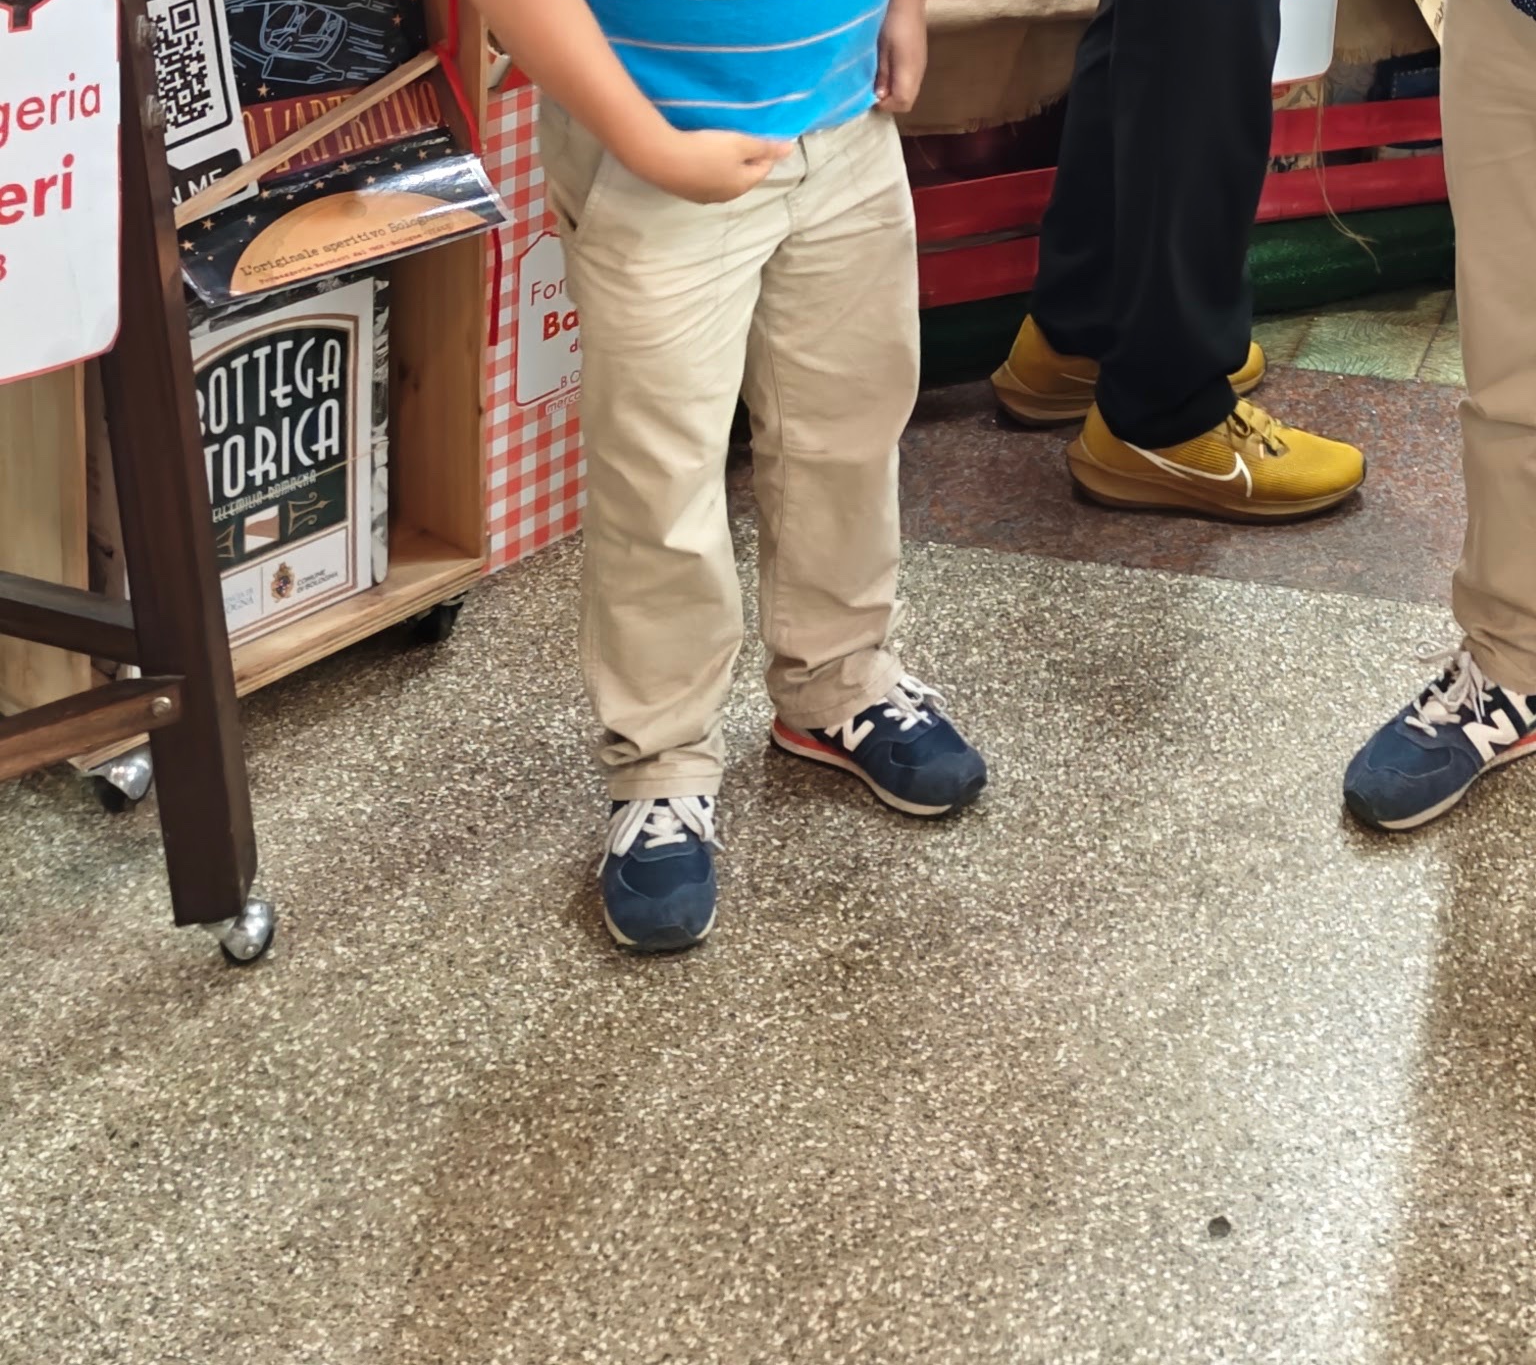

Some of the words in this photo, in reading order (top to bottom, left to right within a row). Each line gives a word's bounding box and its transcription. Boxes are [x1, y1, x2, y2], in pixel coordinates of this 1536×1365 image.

[239, 241, 320, 278] L'originale
[322, 228, 387, 253] aperitivo
[204, 398, 340, 505] TORICA
[212, 468, 317, 523] ELL'EMILIA-ROMAGNA
